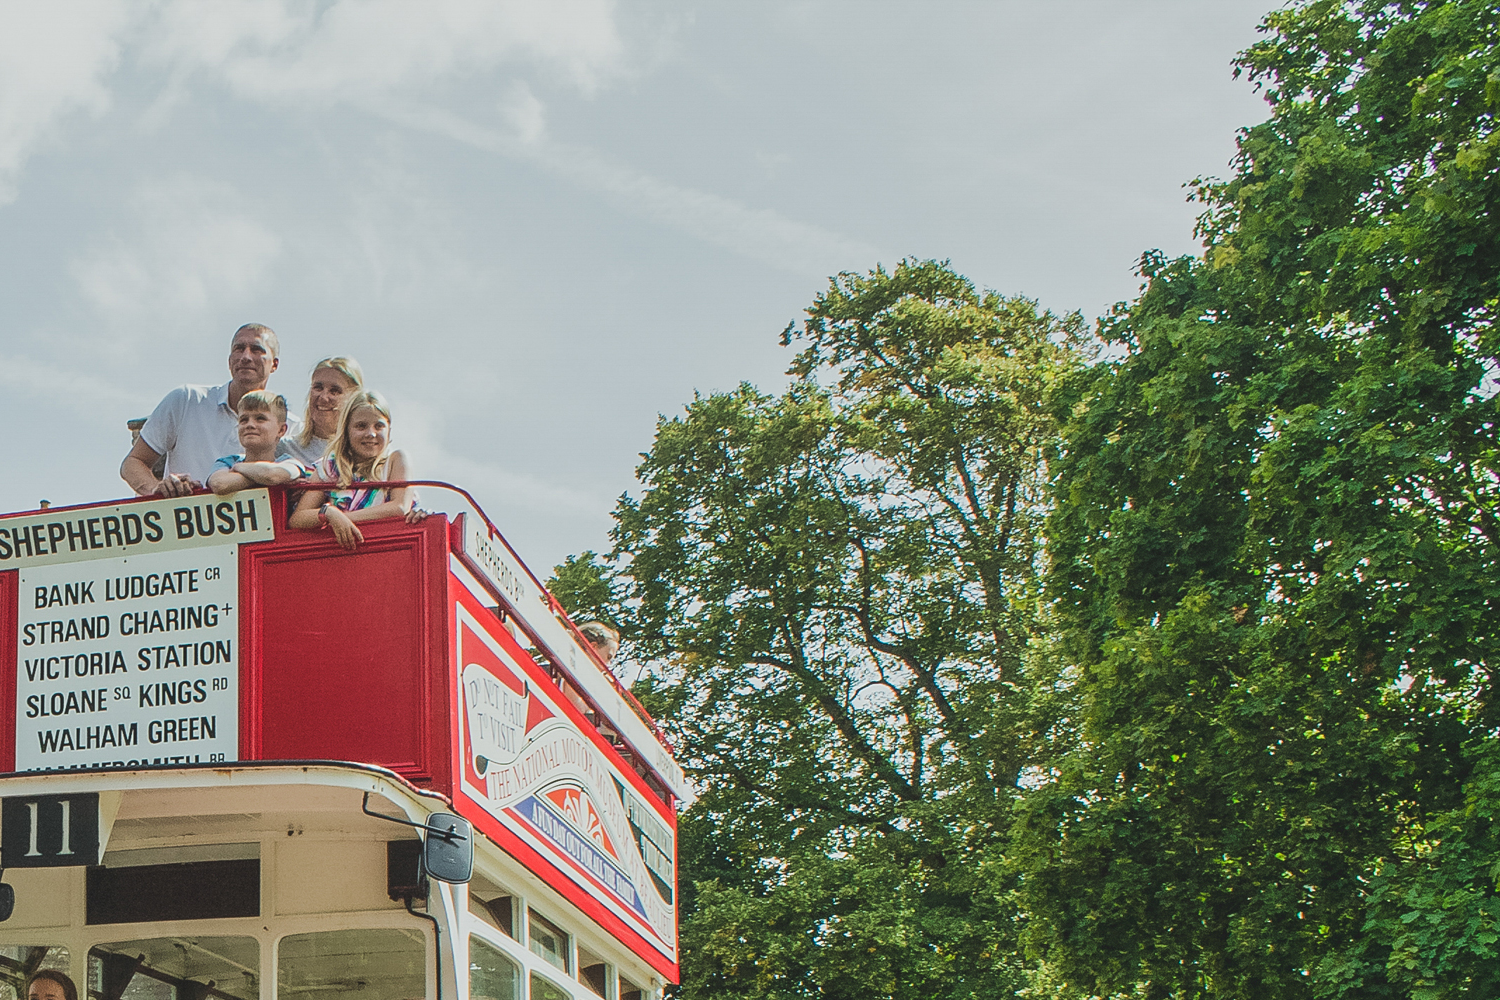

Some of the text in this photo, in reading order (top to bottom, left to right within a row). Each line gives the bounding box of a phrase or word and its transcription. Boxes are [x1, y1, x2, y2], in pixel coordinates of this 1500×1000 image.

[174, 499, 259, 540] BUSH
[476, 531, 513, 597] SHEPHERDS
[34, 567, 221, 609] BANK LUDGATE CR
[22, 616, 110, 646] STRAND
[120, 604, 219, 636] CHARING
[25, 640, 232, 682] VICTORIA STATION
[26, 677, 228, 719] SLOANE SQ KINGS RD
[503, 690, 524, 729] FAIL
[38, 716, 217, 754] WALHAM GREEN
[490, 715, 515, 755] VISIT
[490, 768, 512, 800] THE
[513, 741, 560, 793] NATIONAL
[561, 737, 594, 779] MOTOR
[23, 800, 75, 856] 11
[538, 805, 553, 837] FUN
[553, 819, 566, 848] DAY
[566, 831, 581, 860] OUT
